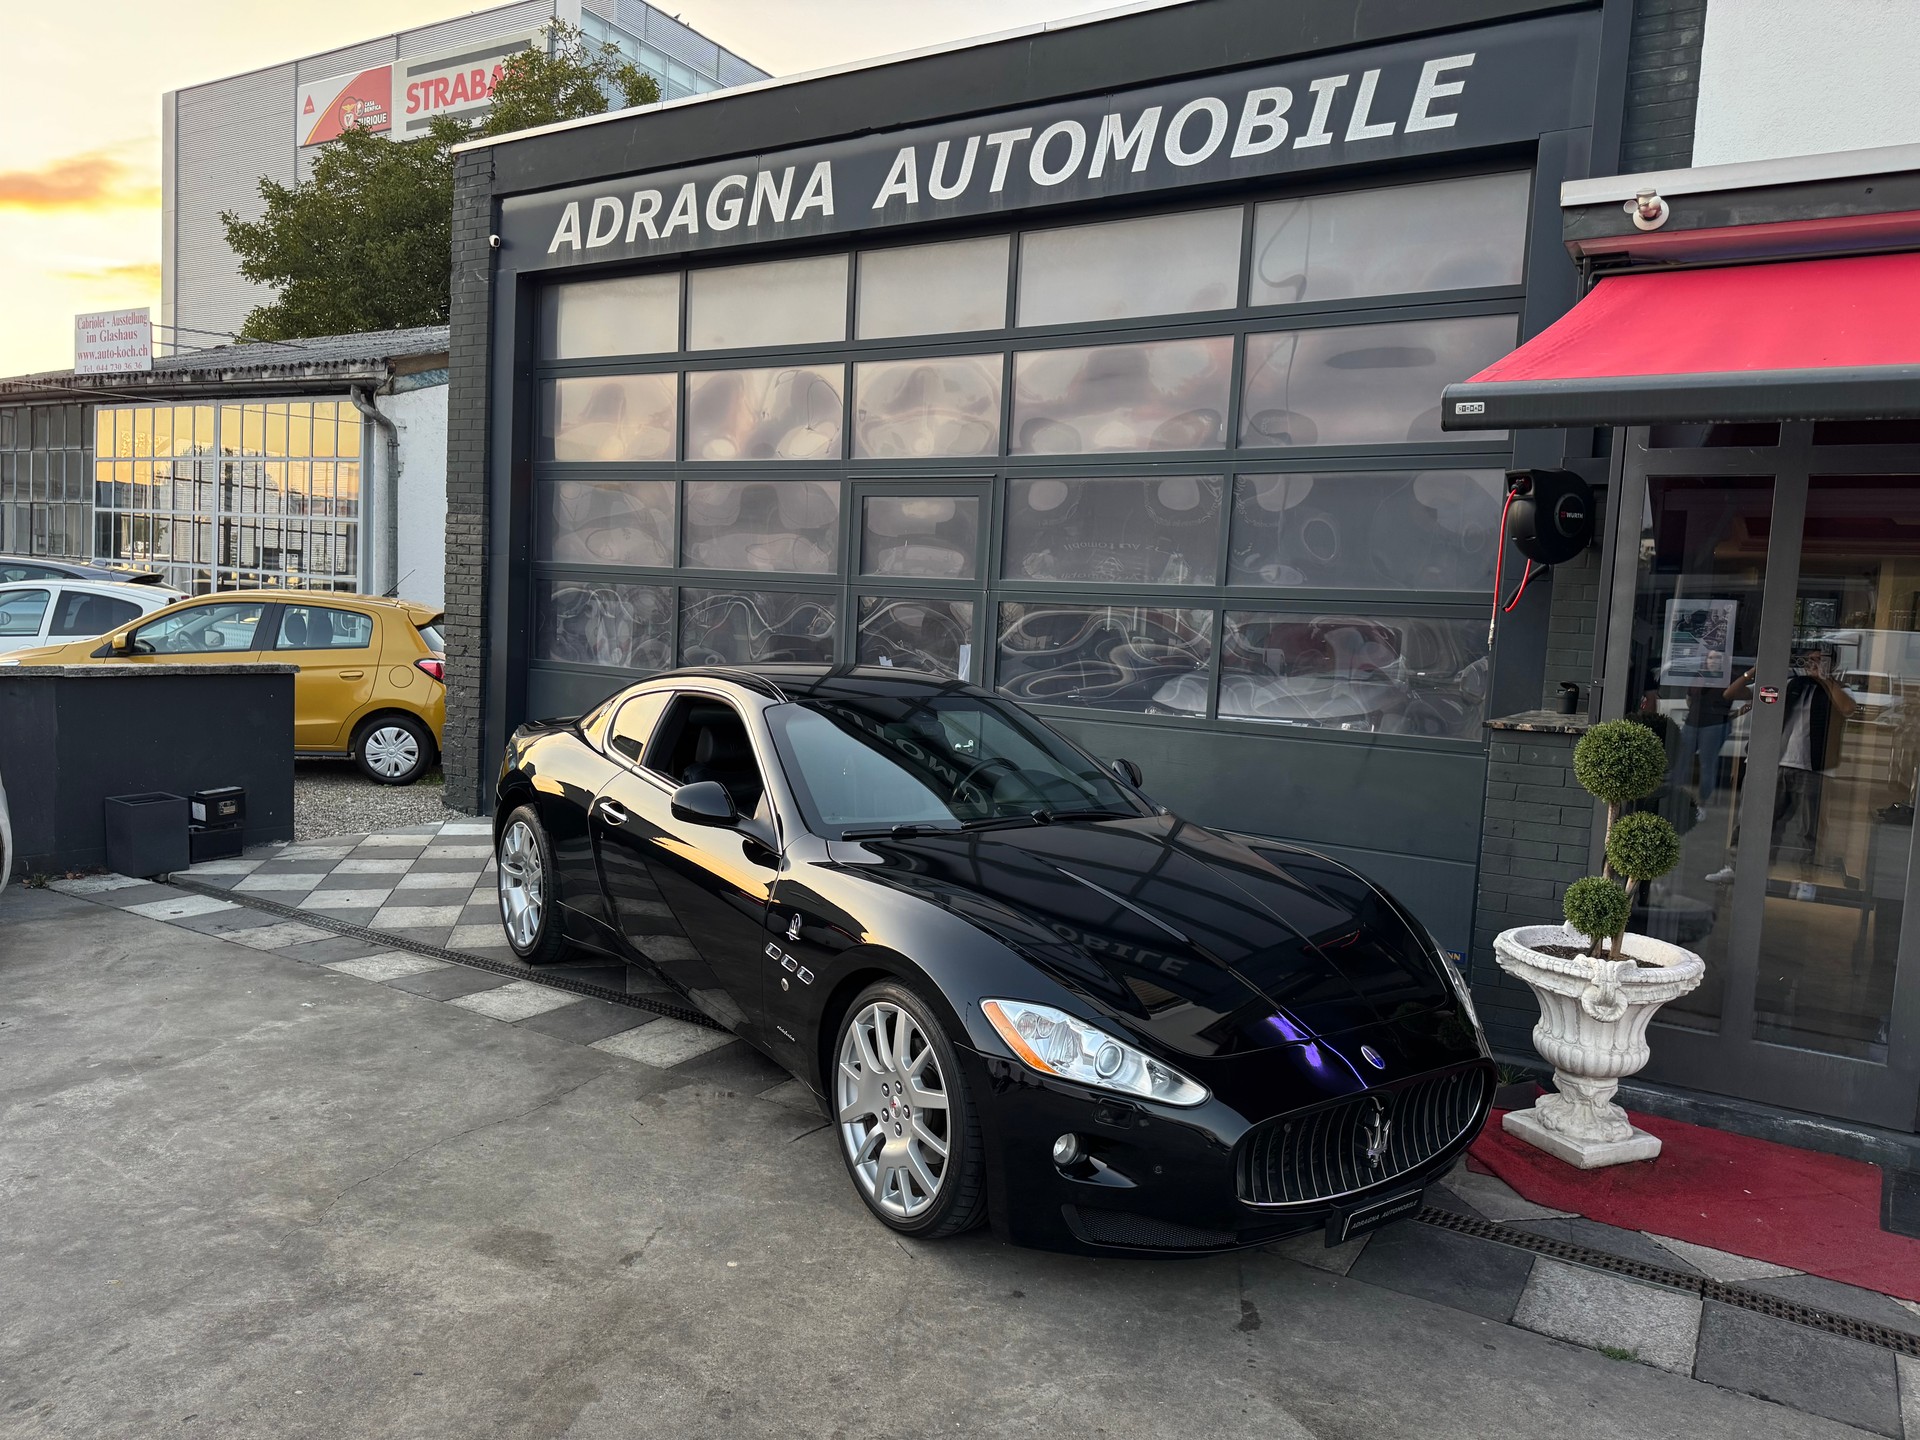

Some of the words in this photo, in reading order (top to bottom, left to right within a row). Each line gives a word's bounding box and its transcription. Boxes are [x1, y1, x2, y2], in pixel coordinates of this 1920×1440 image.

[406, 63, 525, 114] STRABA
[547, 160, 835, 255] ADRAGNA
[871, 53, 1476, 209] AUTOMOBILE
[77, 315, 105, 330] Cabriolet
[111, 312, 148, 327] Ausstellung
[86, 331, 97, 343] im
[99, 329, 138, 343] Glashaus
[77, 344, 148, 360] www.auto-koch.ch
